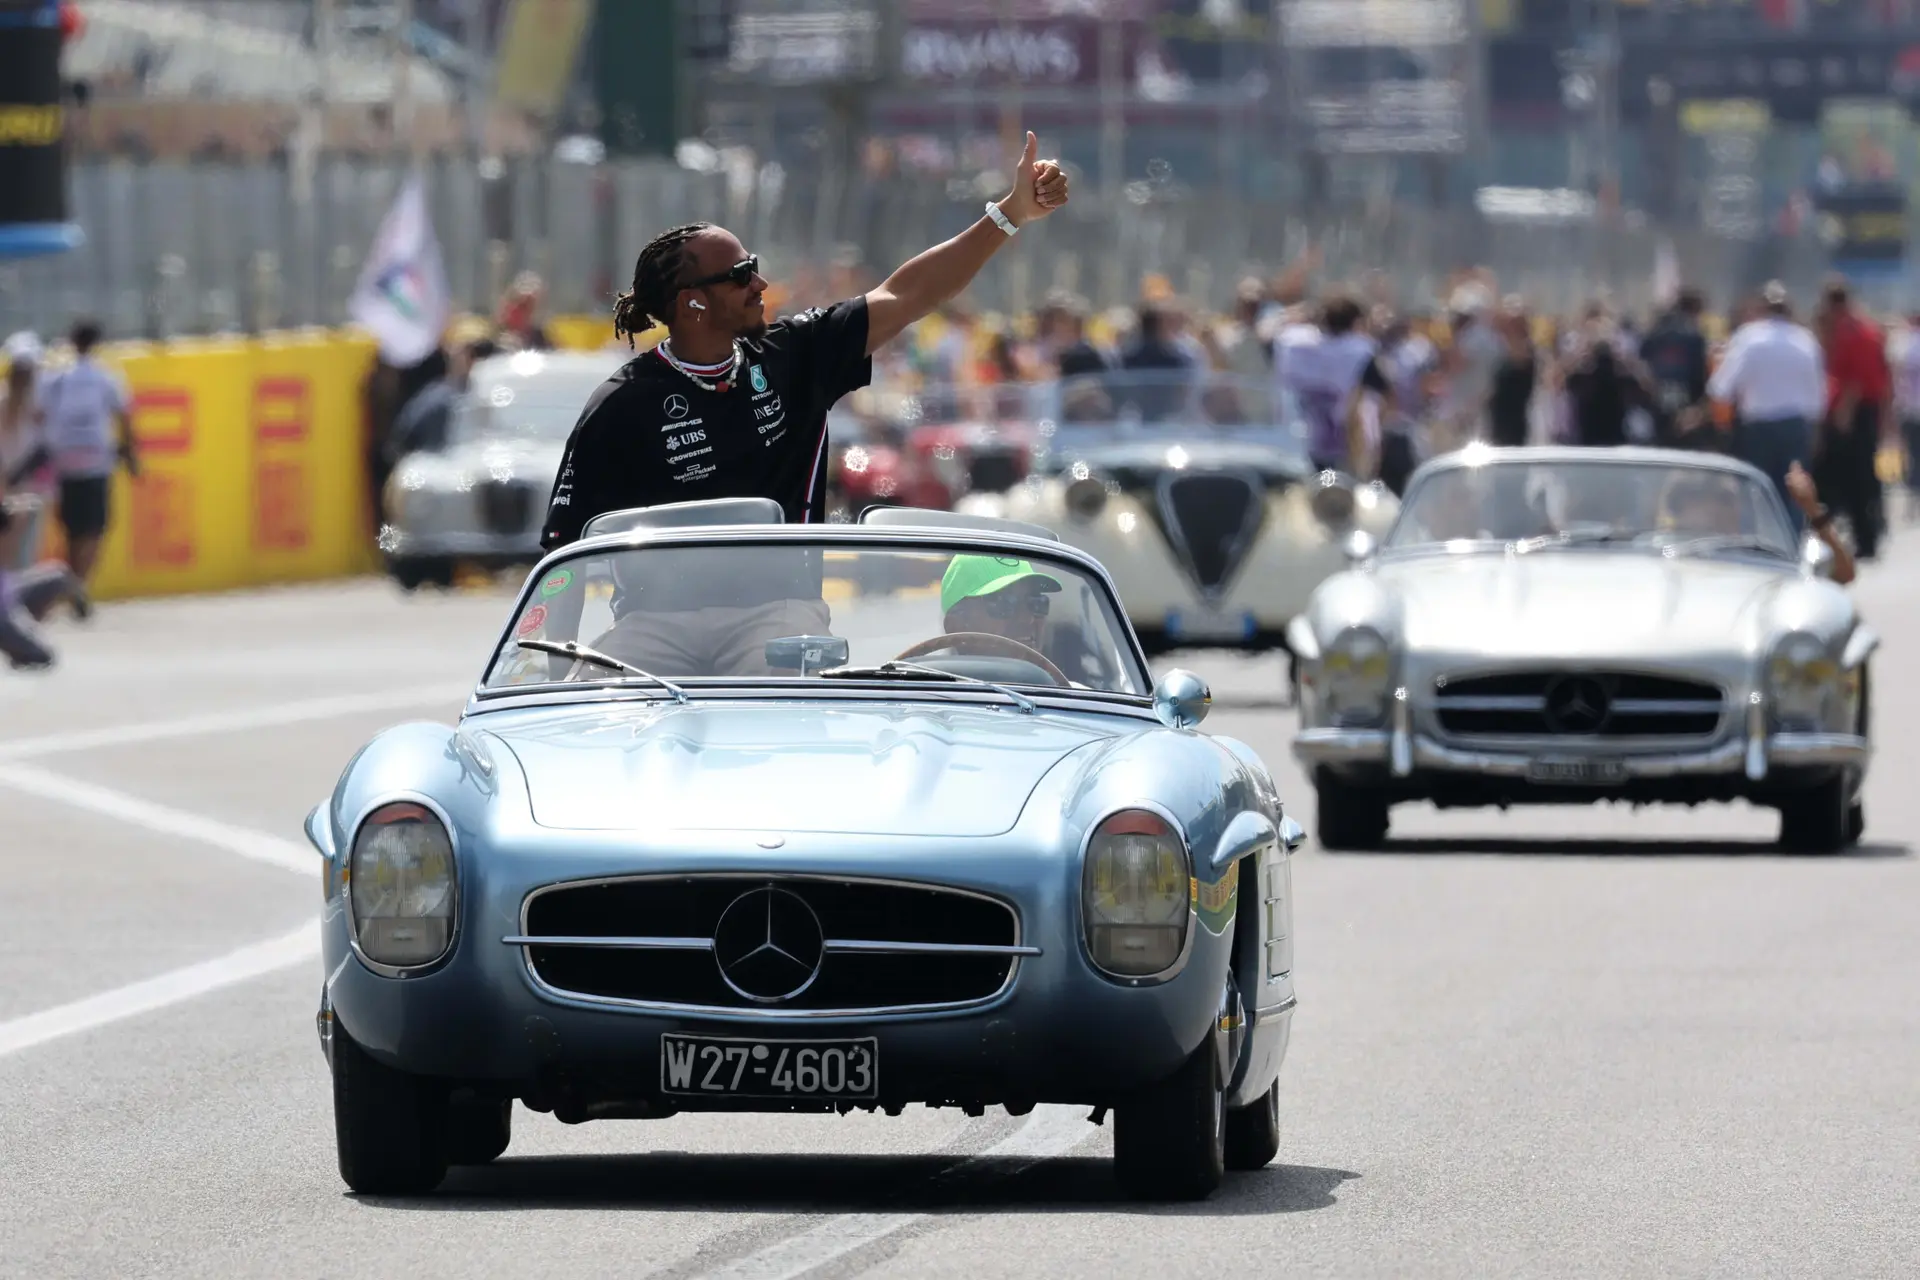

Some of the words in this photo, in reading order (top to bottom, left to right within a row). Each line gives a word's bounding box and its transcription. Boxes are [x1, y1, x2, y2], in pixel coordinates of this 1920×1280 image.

[751, 388, 774, 402] PETRONA
[680, 429, 707, 445] UBS
[669, 446, 713, 462] CROWDSTRIKE
[694, 464, 717, 476] Packard
